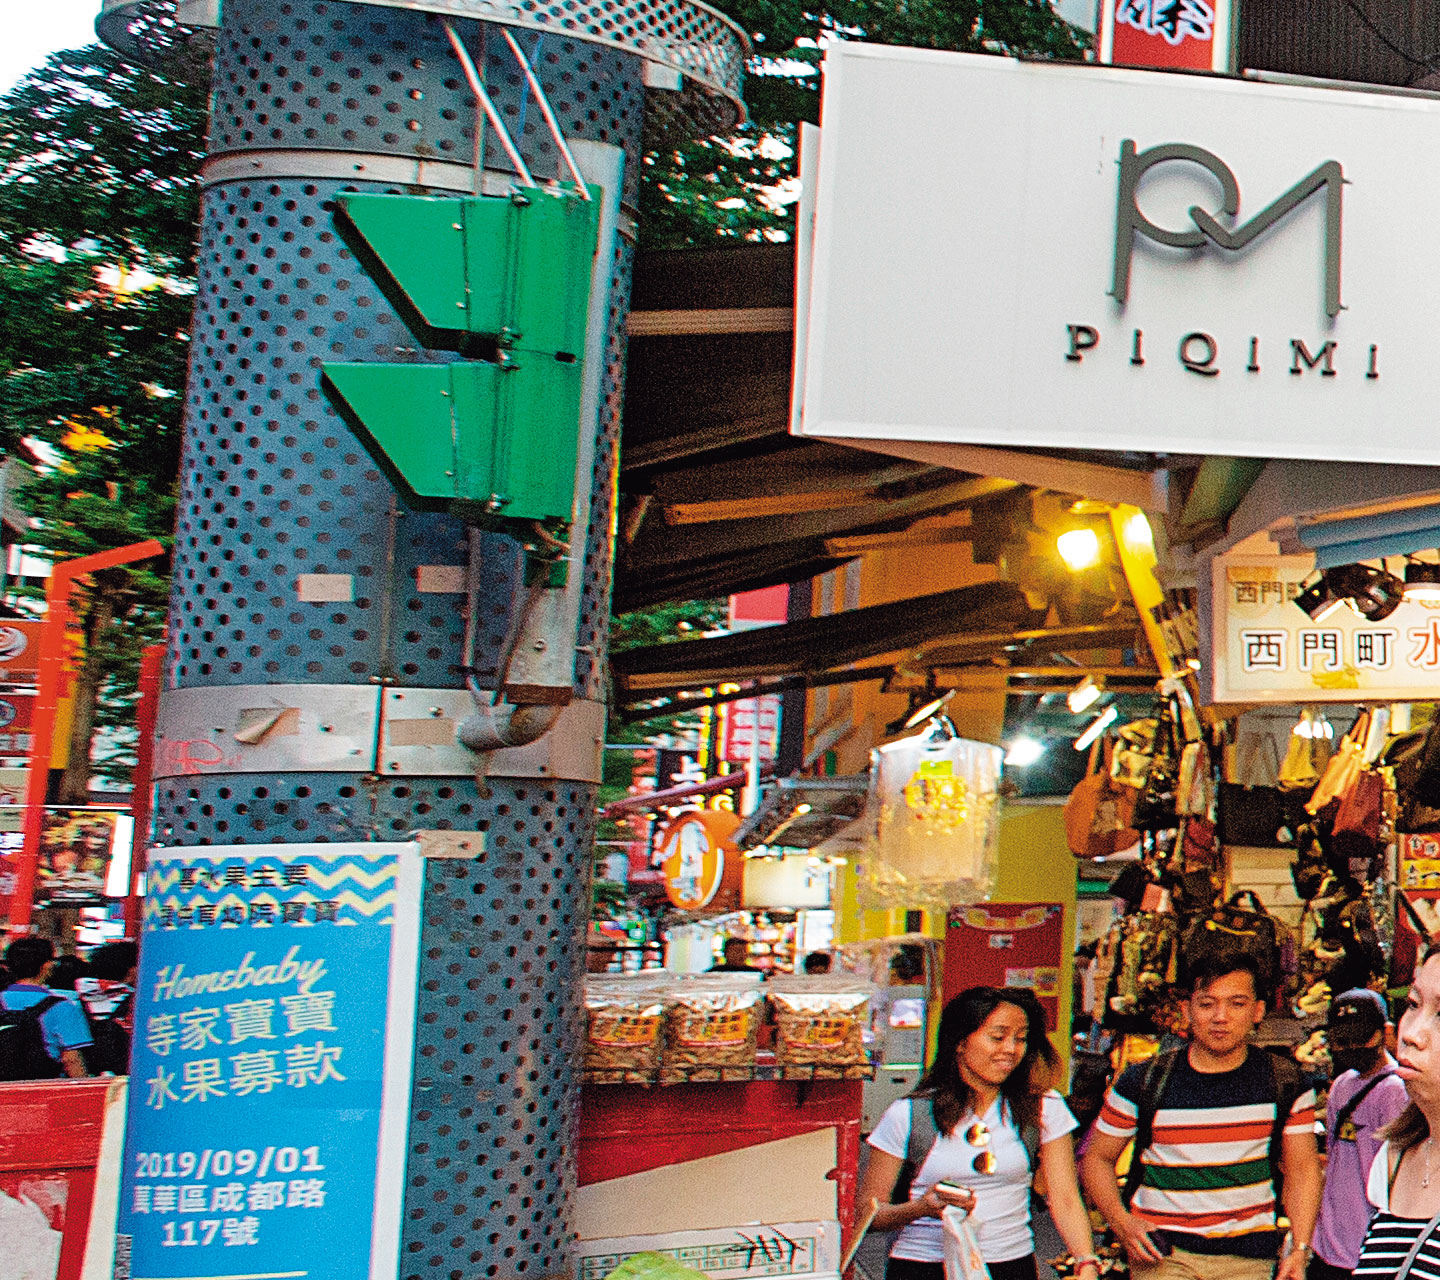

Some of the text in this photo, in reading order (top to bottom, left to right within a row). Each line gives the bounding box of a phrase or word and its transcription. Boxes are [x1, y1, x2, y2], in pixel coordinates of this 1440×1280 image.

[153, 945, 328, 1002] Homebaby
[146, 991, 339, 1056] 等家寶寶
[145, 1041, 348, 1110] 水果募款
[135, 1146, 326, 1180] 2019/09/01
[161, 1216, 260, 1247] 117號
